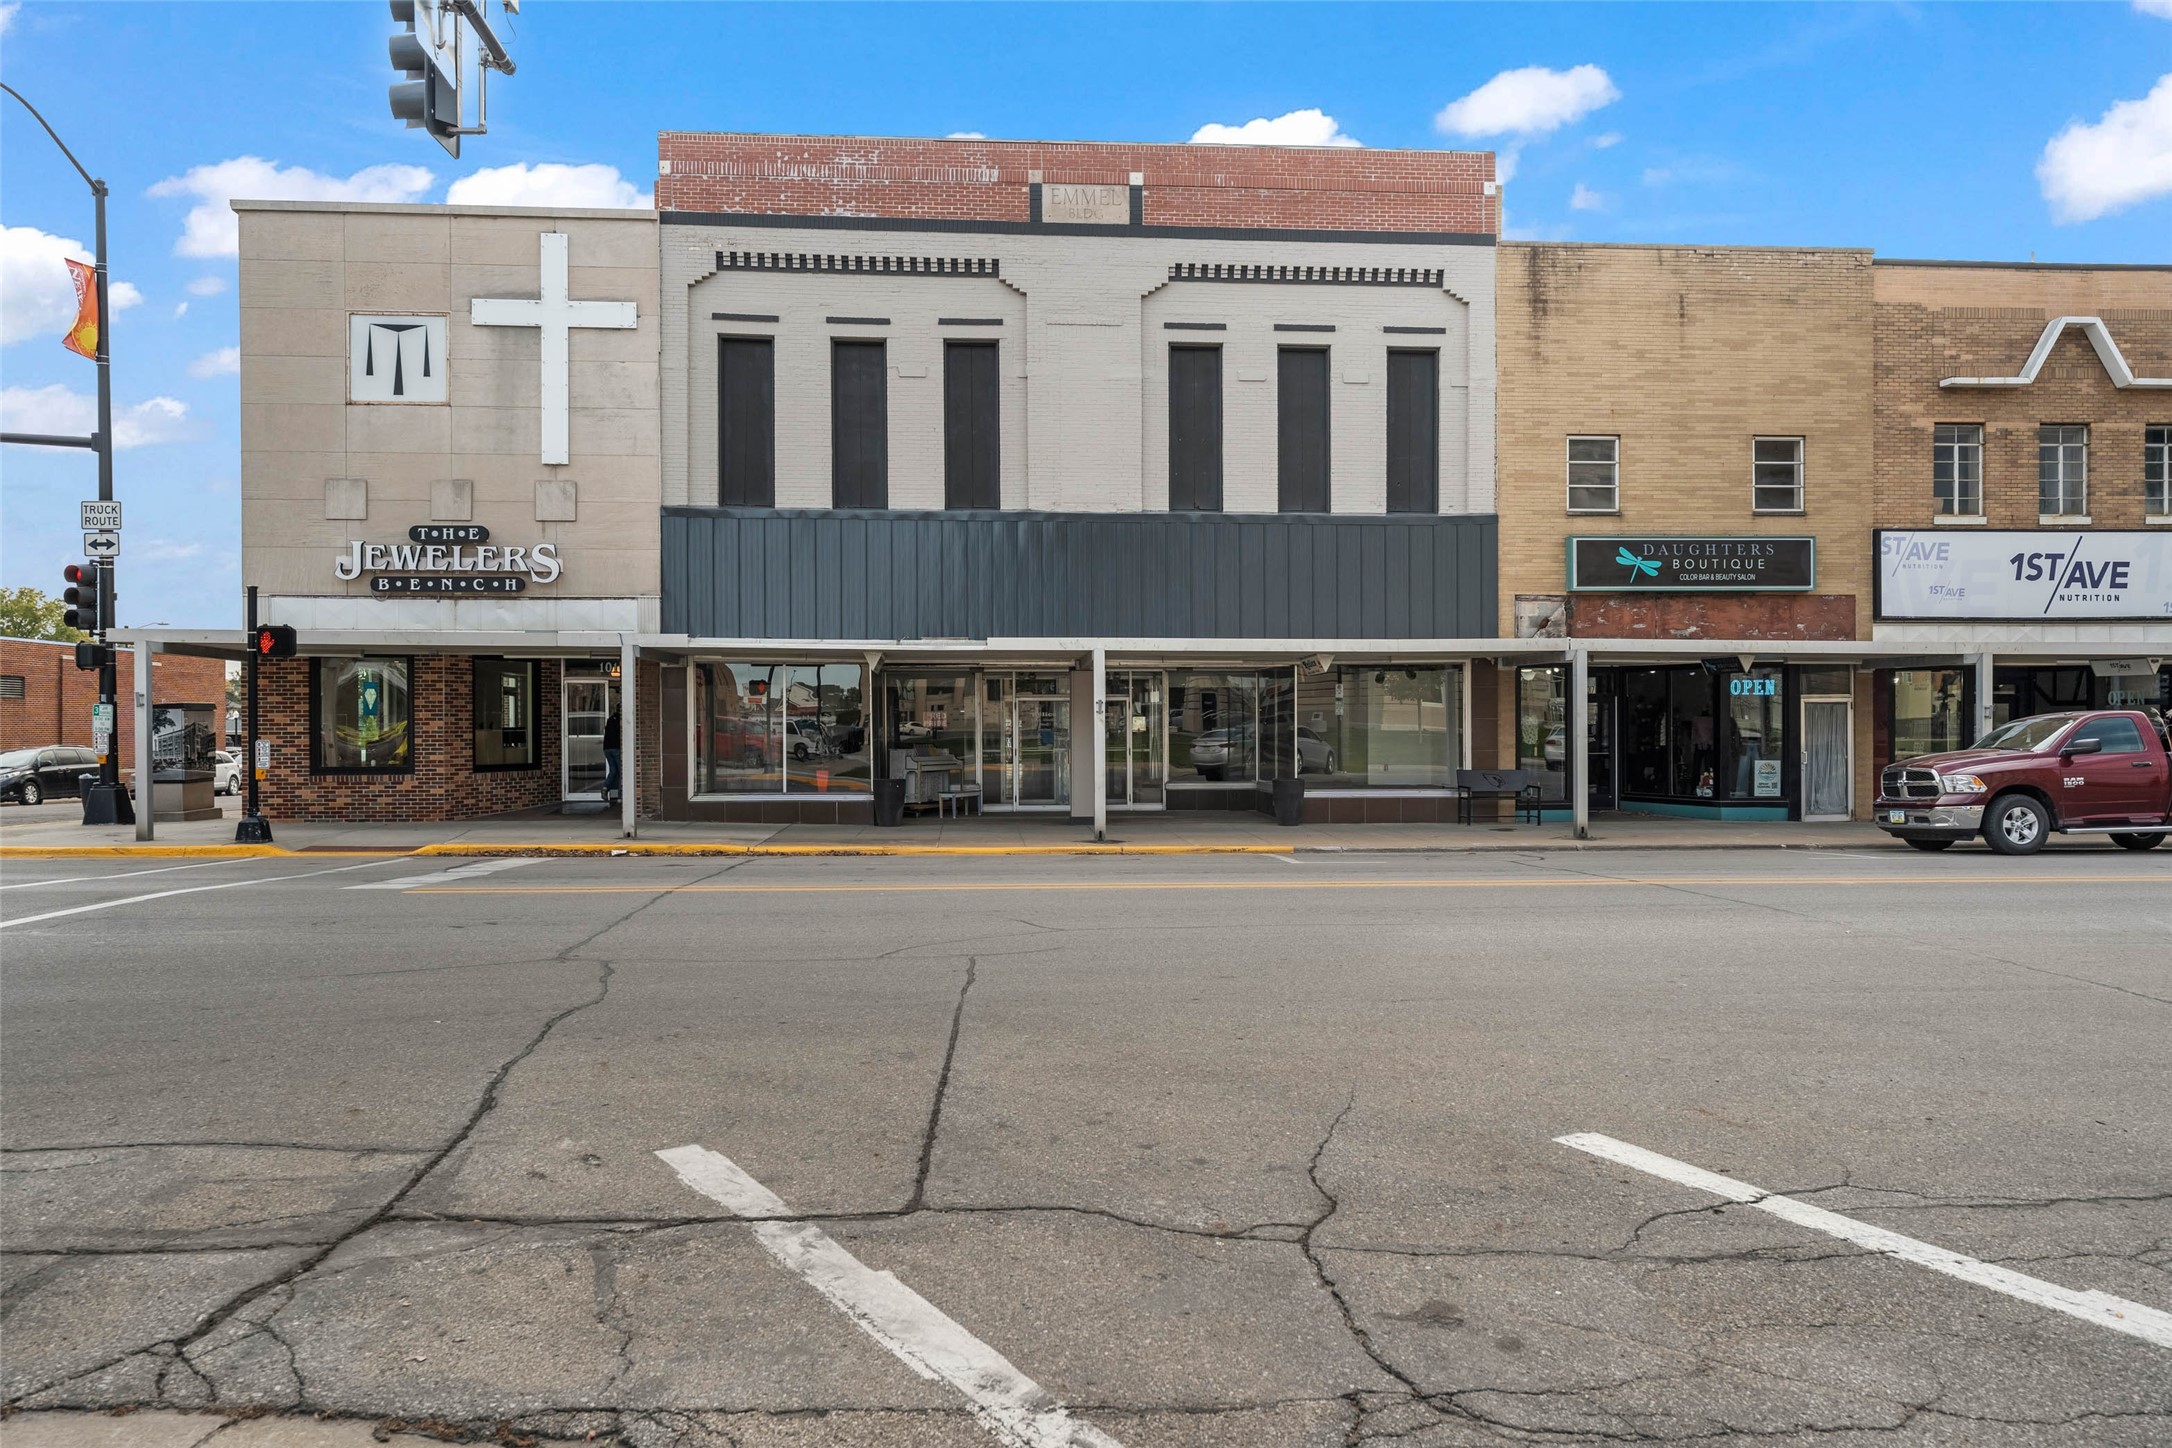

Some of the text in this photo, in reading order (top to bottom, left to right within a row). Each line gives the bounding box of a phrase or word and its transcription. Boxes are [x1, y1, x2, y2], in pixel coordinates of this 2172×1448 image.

[1051, 188, 1122, 206] EMMEL
[1068, 208, 1104, 219] BLDG
[83, 505, 118, 514] TRUCK
[84, 517, 119, 526] ROUTE
[1643, 543, 1774, 556] DAUGHTERS
[334, 540, 561, 584] JEWELERS
[1672, 558, 1765, 569] BOUTIQUE
[1679, 573, 1756, 581] COLOR BAR & BEAUTY SALON
[2059, 594, 2120, 602] NUTRITION
[1730, 679, 1775, 695] OPEN
[2108, 690, 2145, 706] OPEN
